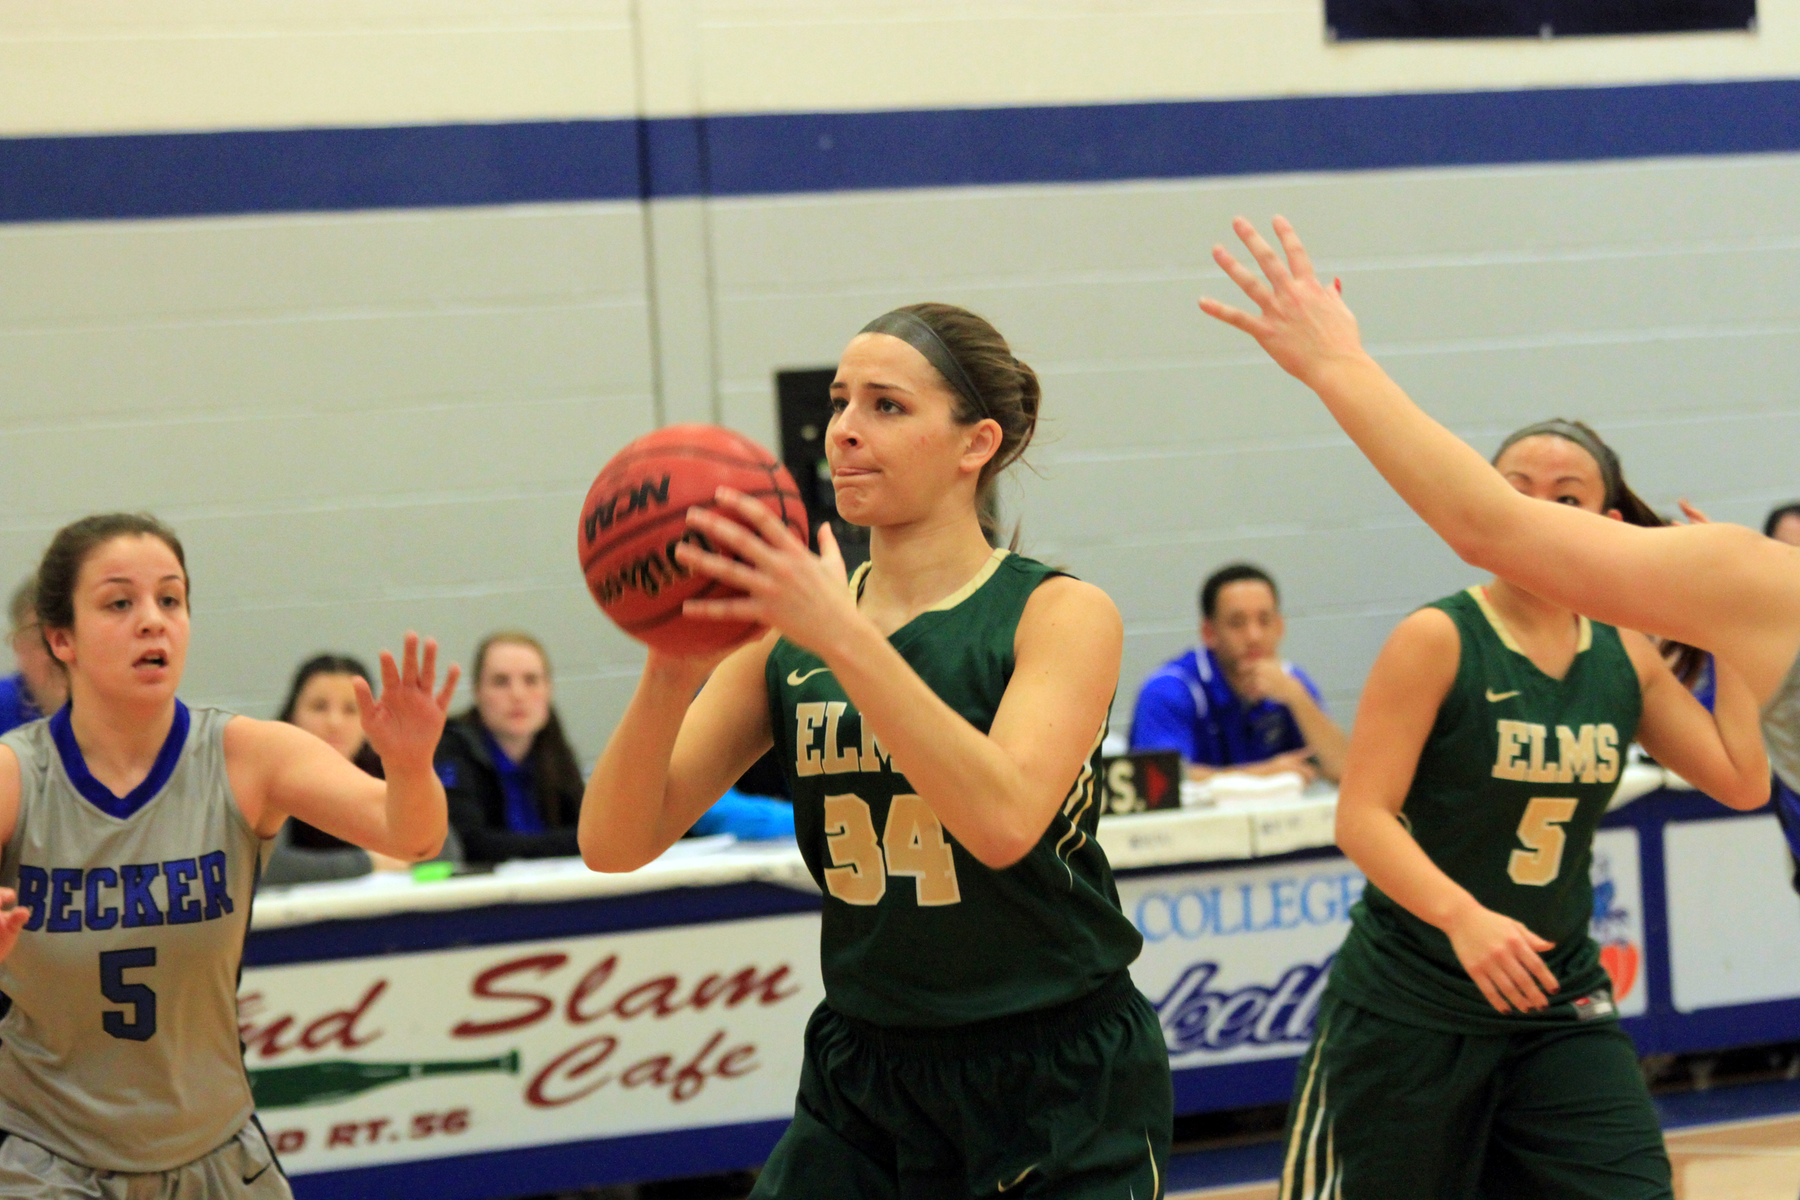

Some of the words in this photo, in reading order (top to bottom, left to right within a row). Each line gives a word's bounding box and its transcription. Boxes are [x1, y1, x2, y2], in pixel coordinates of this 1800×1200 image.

[795, 701, 905, 777] ELM
[1491, 719, 1620, 784] ELMS
[823, 793, 962, 907] 34
[1507, 797, 1579, 886] 5
[18, 850, 234, 932] BECKER
[1135, 873, 1367, 943] COLLEGE
[99, 946, 157, 1042] 5
[450, 952, 799, 1040] Slam
[524, 1030, 760, 1109] Cafe
